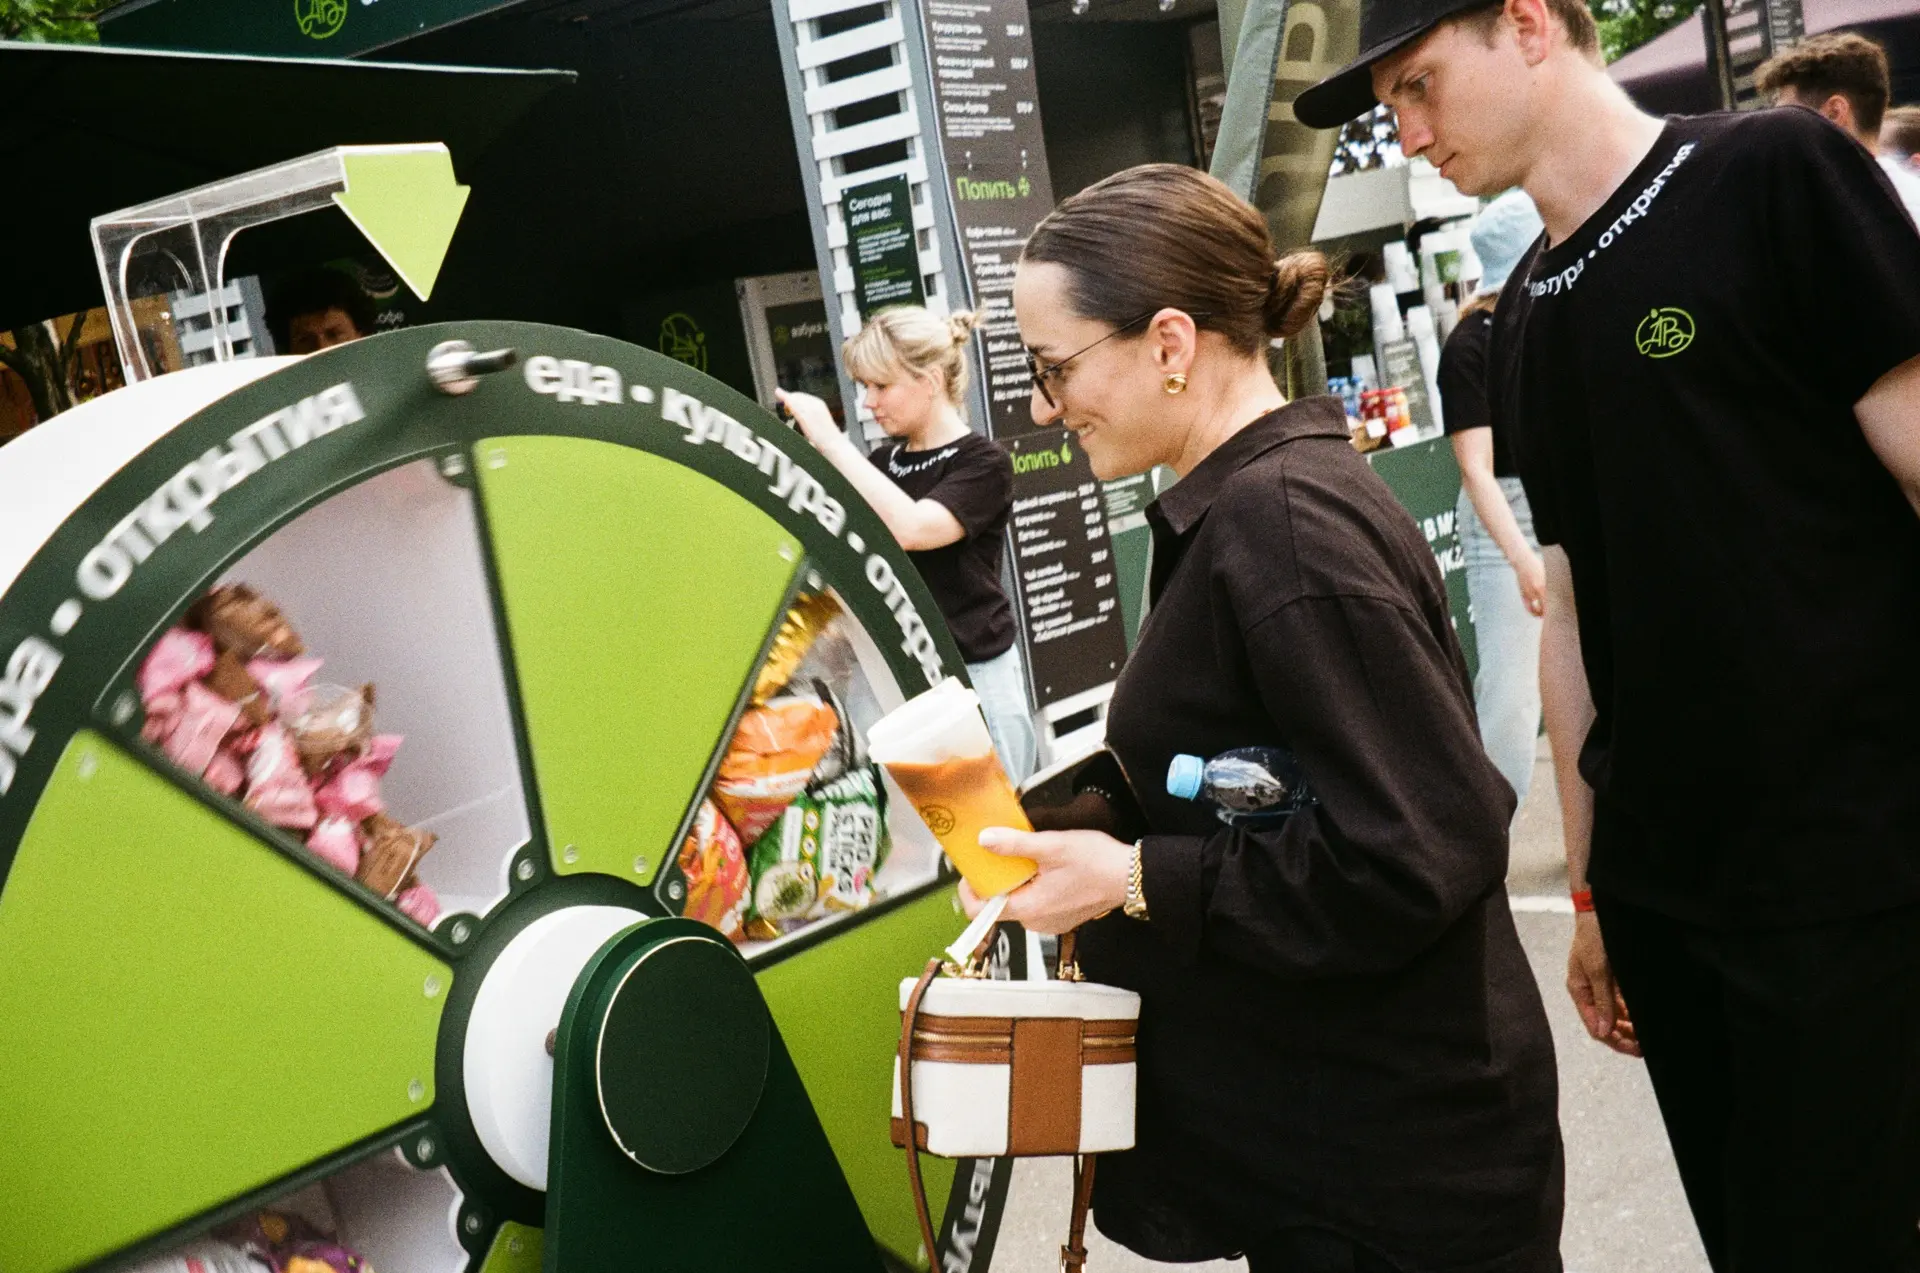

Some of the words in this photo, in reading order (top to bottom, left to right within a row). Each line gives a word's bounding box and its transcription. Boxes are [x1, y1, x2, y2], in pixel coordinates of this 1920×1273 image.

[956, 175, 1016, 200] Попить
[1598, 141, 1697, 249] открытия
[849, 192, 893, 212] Сегодня
[852, 211, 870, 227] для
[76, 380, 366, 600] открытия
[523, 353, 624, 406] еда
[660, 386, 848, 538] культура
